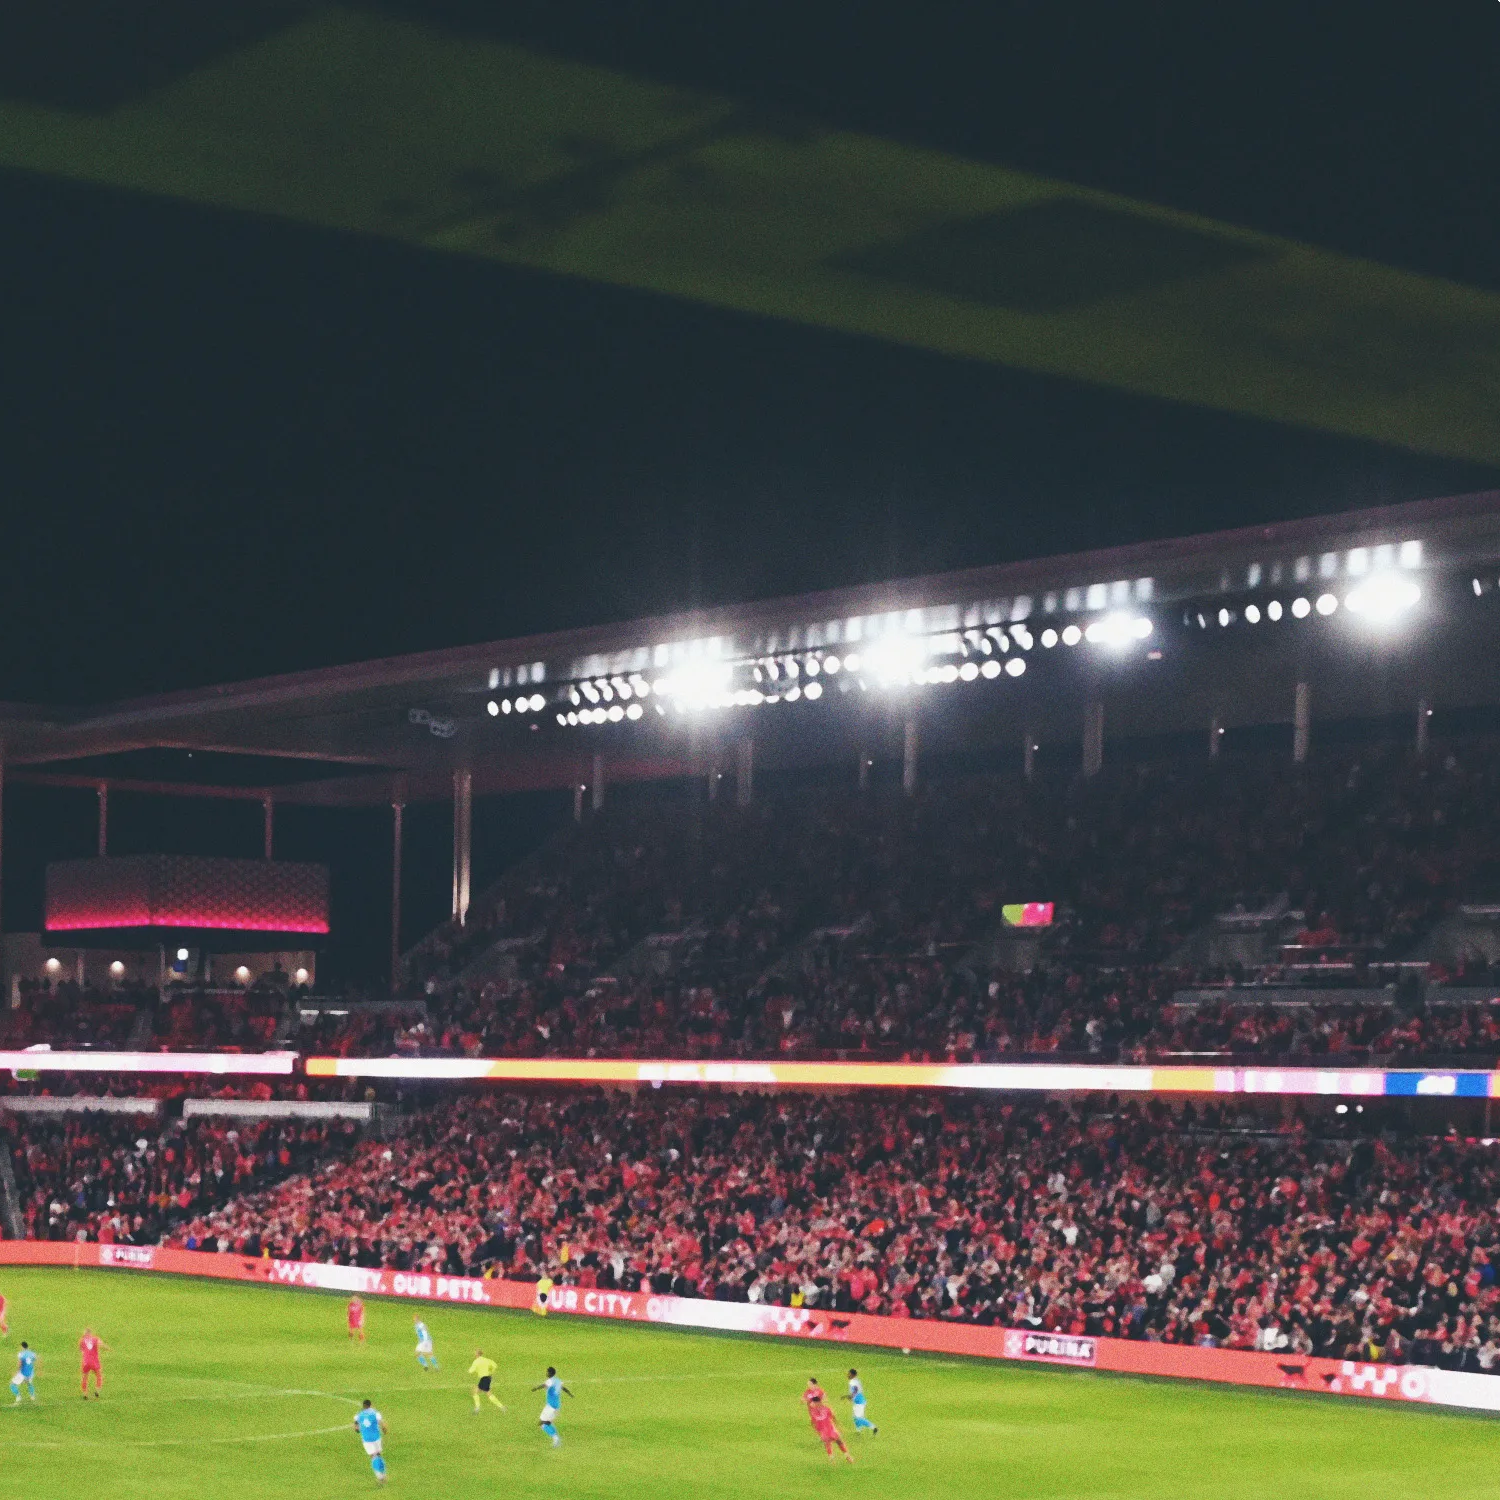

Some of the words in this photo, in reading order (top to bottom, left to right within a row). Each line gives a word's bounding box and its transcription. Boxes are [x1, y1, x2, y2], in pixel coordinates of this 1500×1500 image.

[393, 1274, 431, 1296] OUR
[436, 1277, 490, 1302] PETS.
[548, 1288, 577, 1310] UR
[584, 1291, 637, 1316] CITY.
